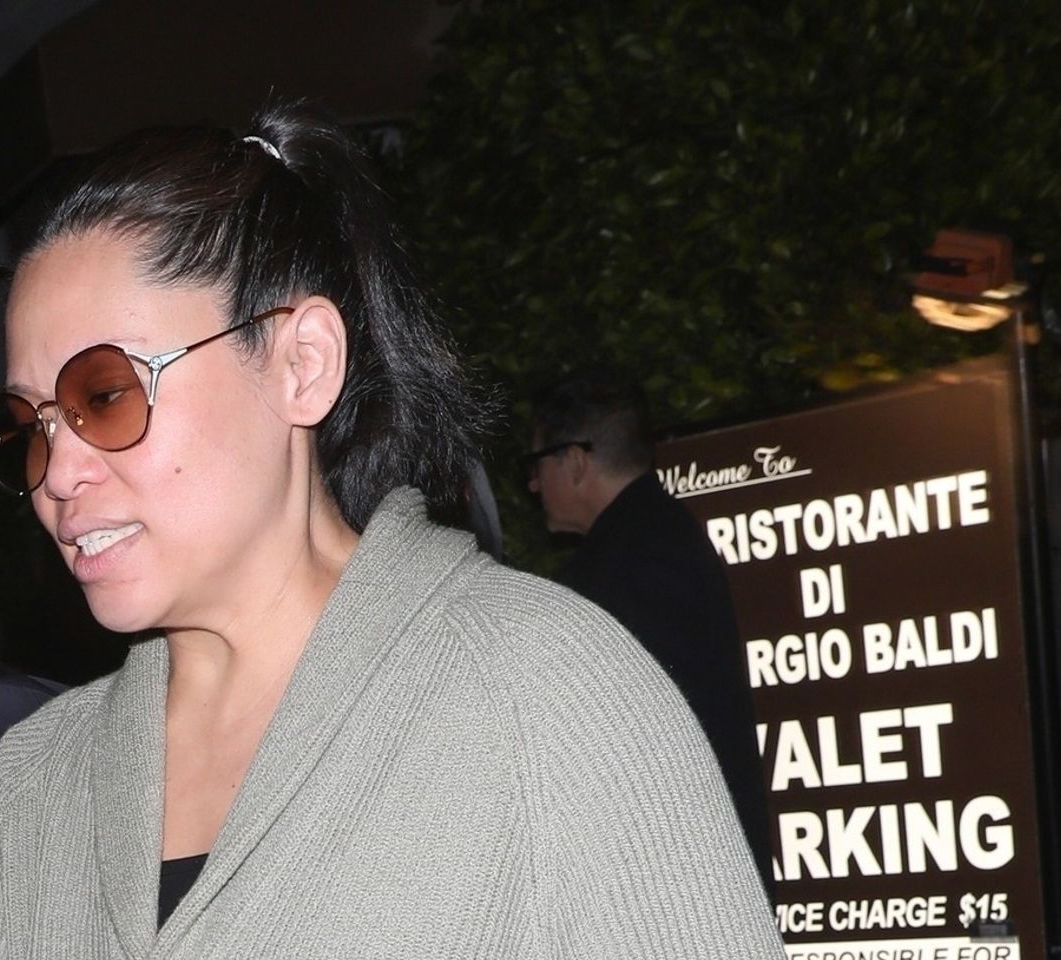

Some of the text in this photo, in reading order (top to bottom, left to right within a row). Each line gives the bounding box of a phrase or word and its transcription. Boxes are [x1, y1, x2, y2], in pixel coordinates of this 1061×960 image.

[656, 445, 797, 496] Welcome To
[706, 469, 991, 566] RISTORANTE
[799, 564, 847, 619] DI
[862, 607, 999, 675] BALDI
[772, 794, 1016, 882] RKING
[775, 892, 1009, 933] ICE CHARGE $15
